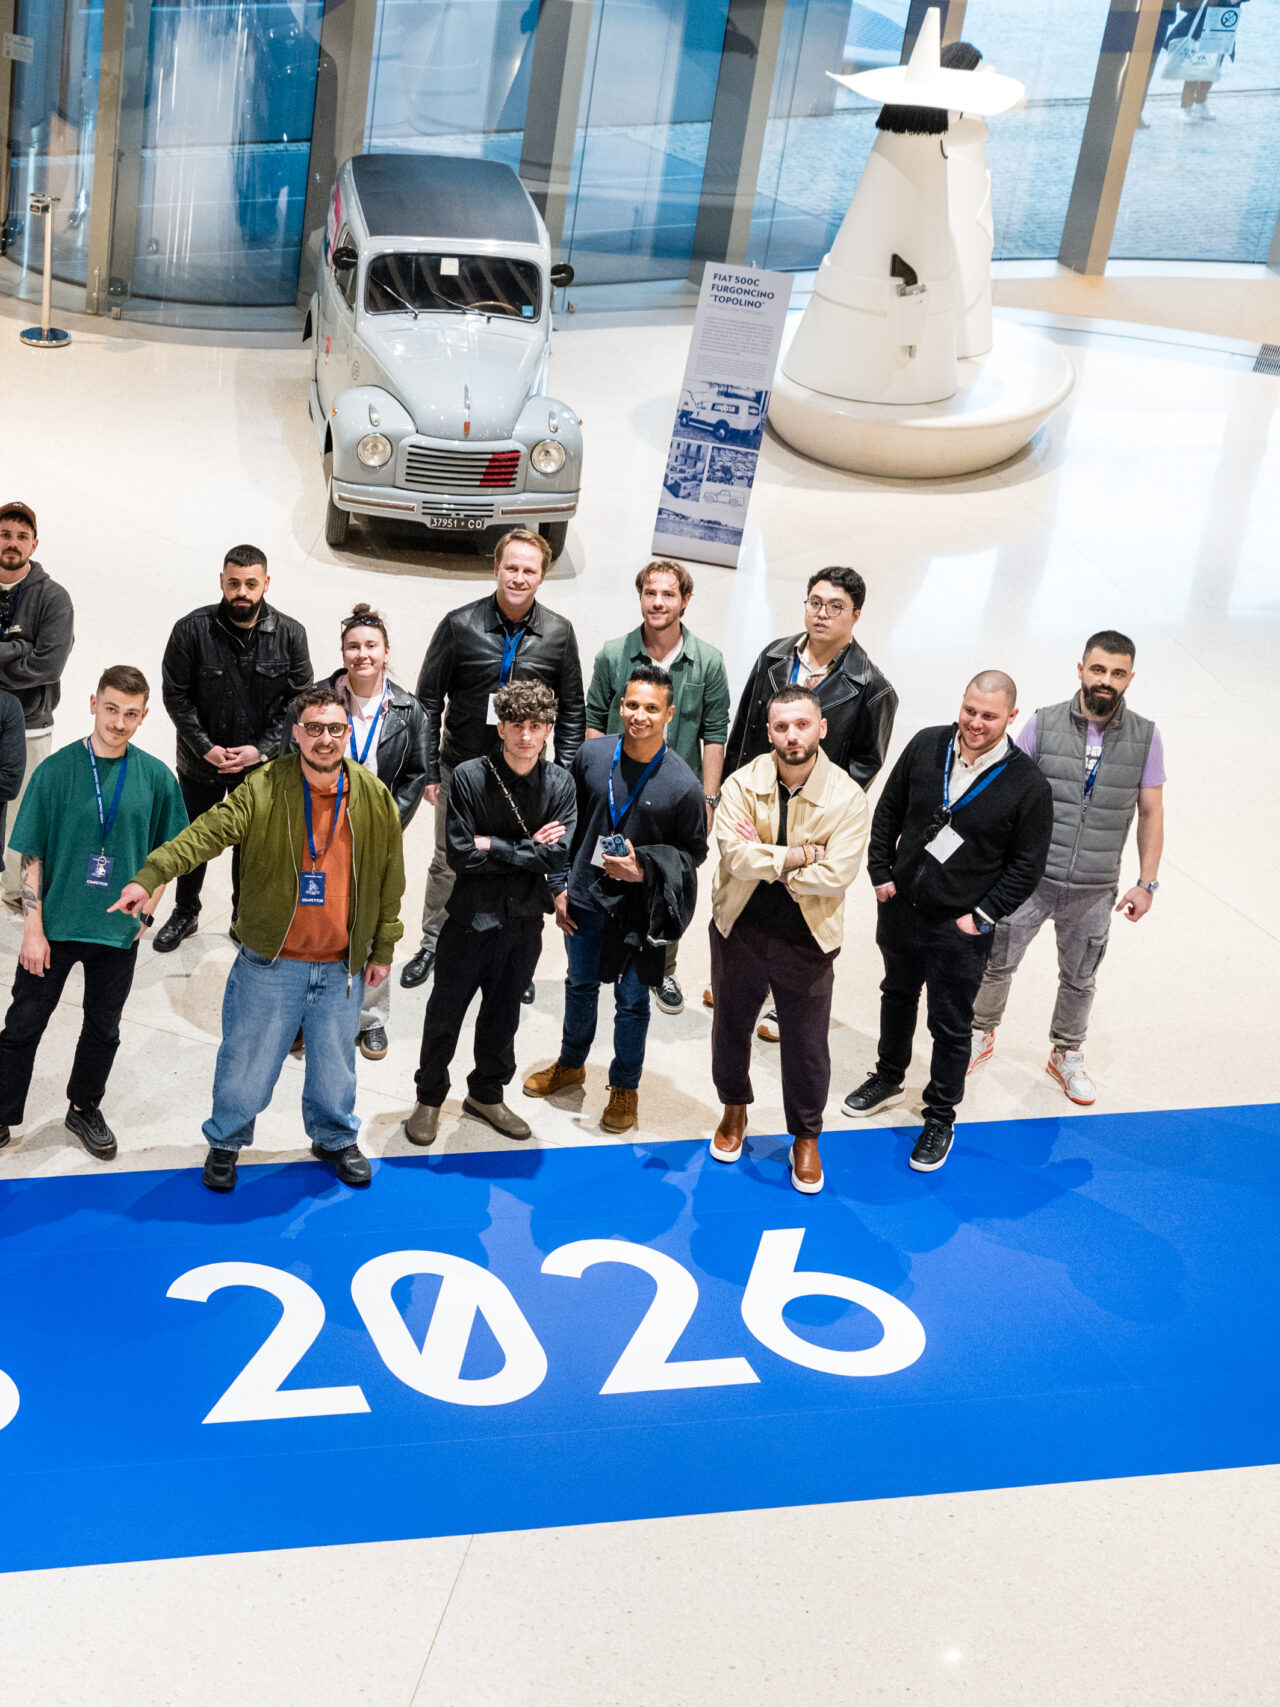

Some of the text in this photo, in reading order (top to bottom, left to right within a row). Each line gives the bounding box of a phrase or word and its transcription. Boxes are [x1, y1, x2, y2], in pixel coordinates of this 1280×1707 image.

[713, 273, 760, 287] FIAT 500C
[711, 284, 775, 300] FURGONCINO
[431, 518, 457, 528] 37951
[166, 1228, 927, 1424] 2026
